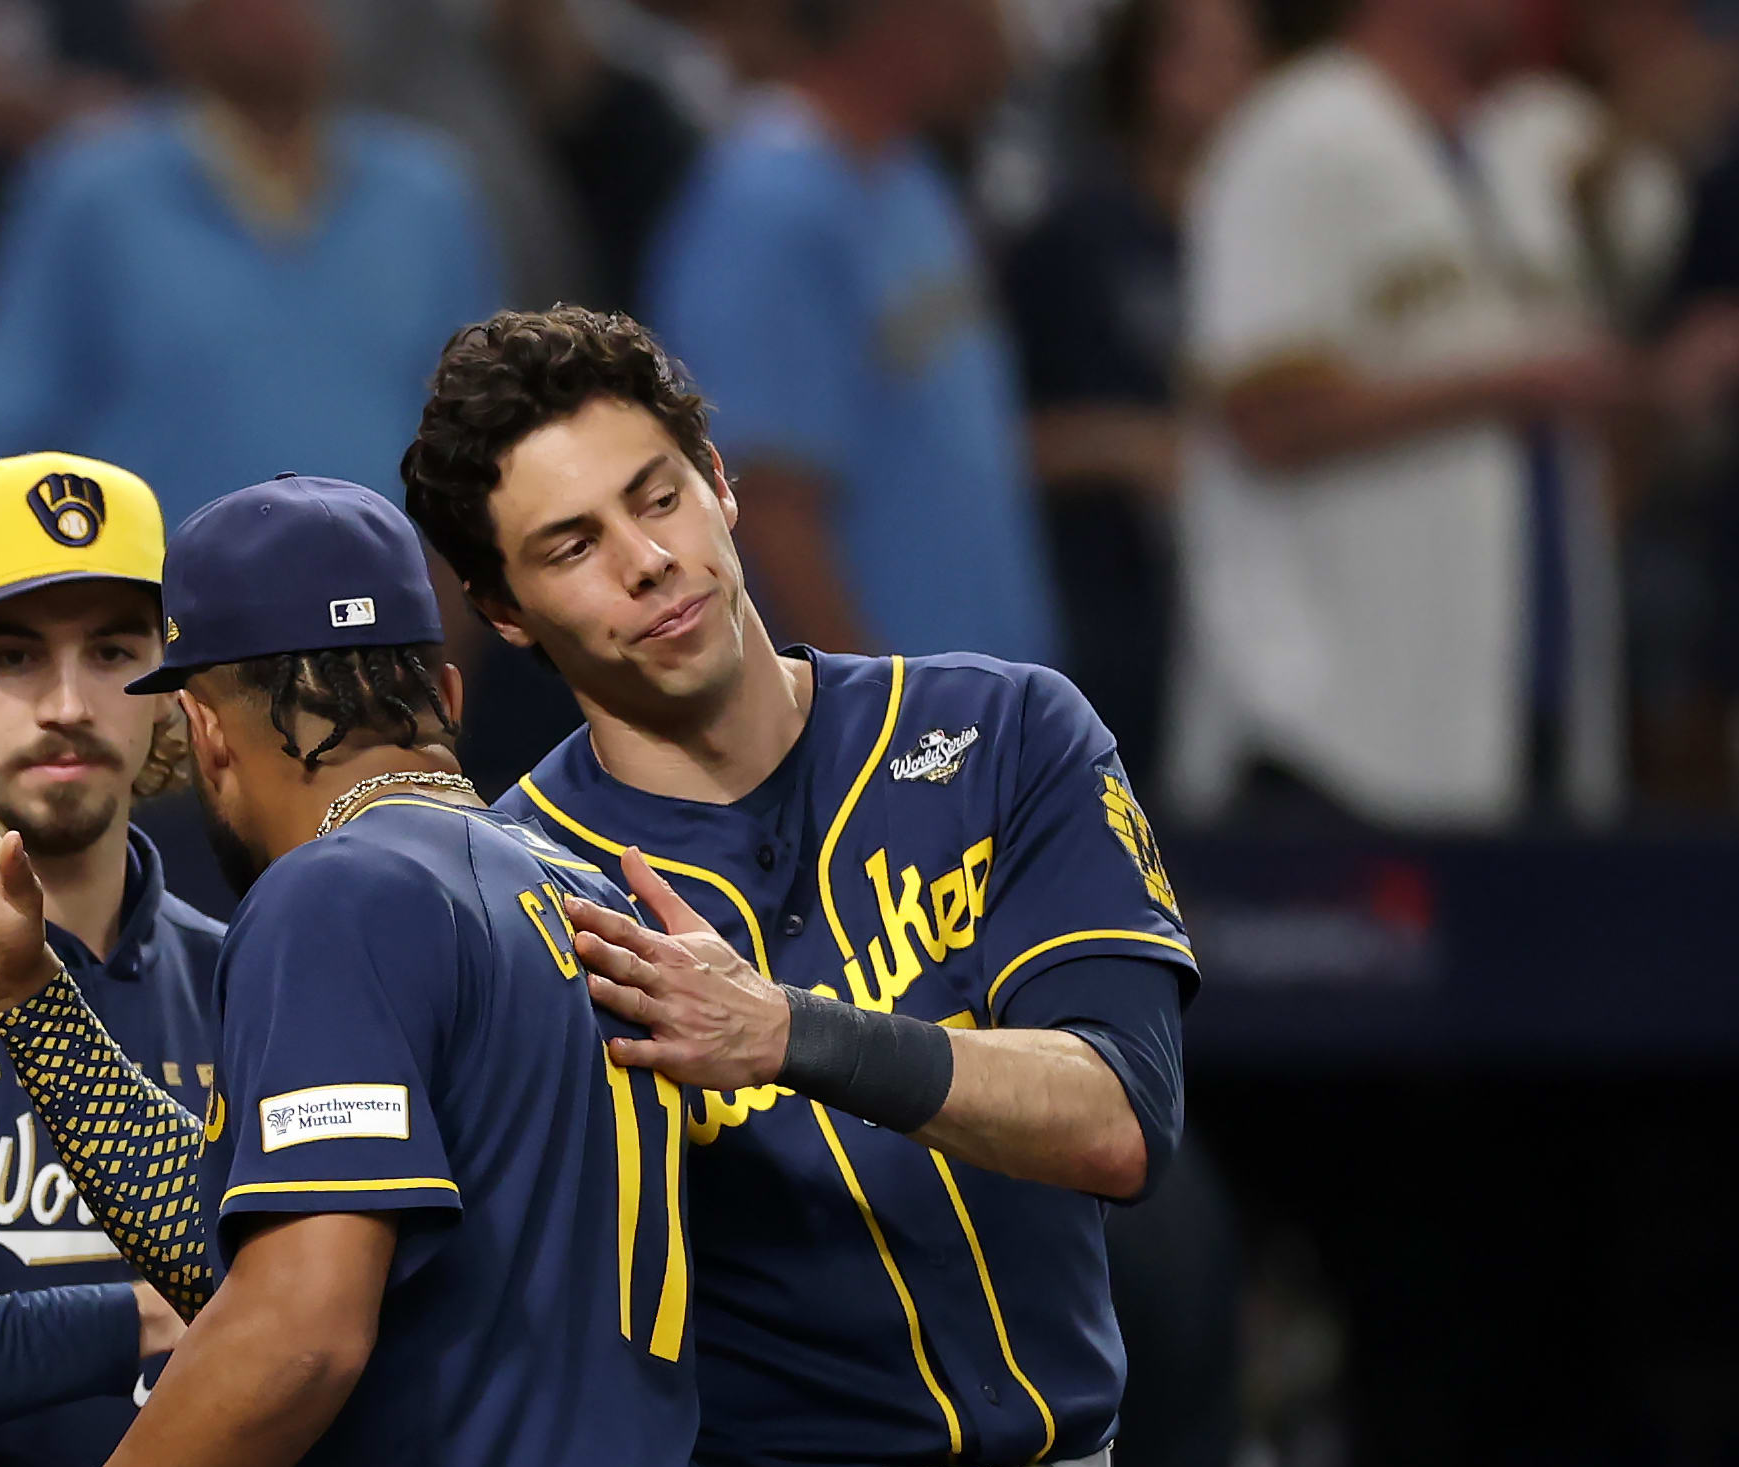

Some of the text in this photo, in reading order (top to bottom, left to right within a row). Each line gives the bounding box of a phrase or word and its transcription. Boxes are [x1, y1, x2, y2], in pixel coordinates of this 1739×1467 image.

[889, 726, 979, 781] World Series
[297, 1098, 402, 1117] Northwestern
[298, 1111, 353, 1130] Mutual
